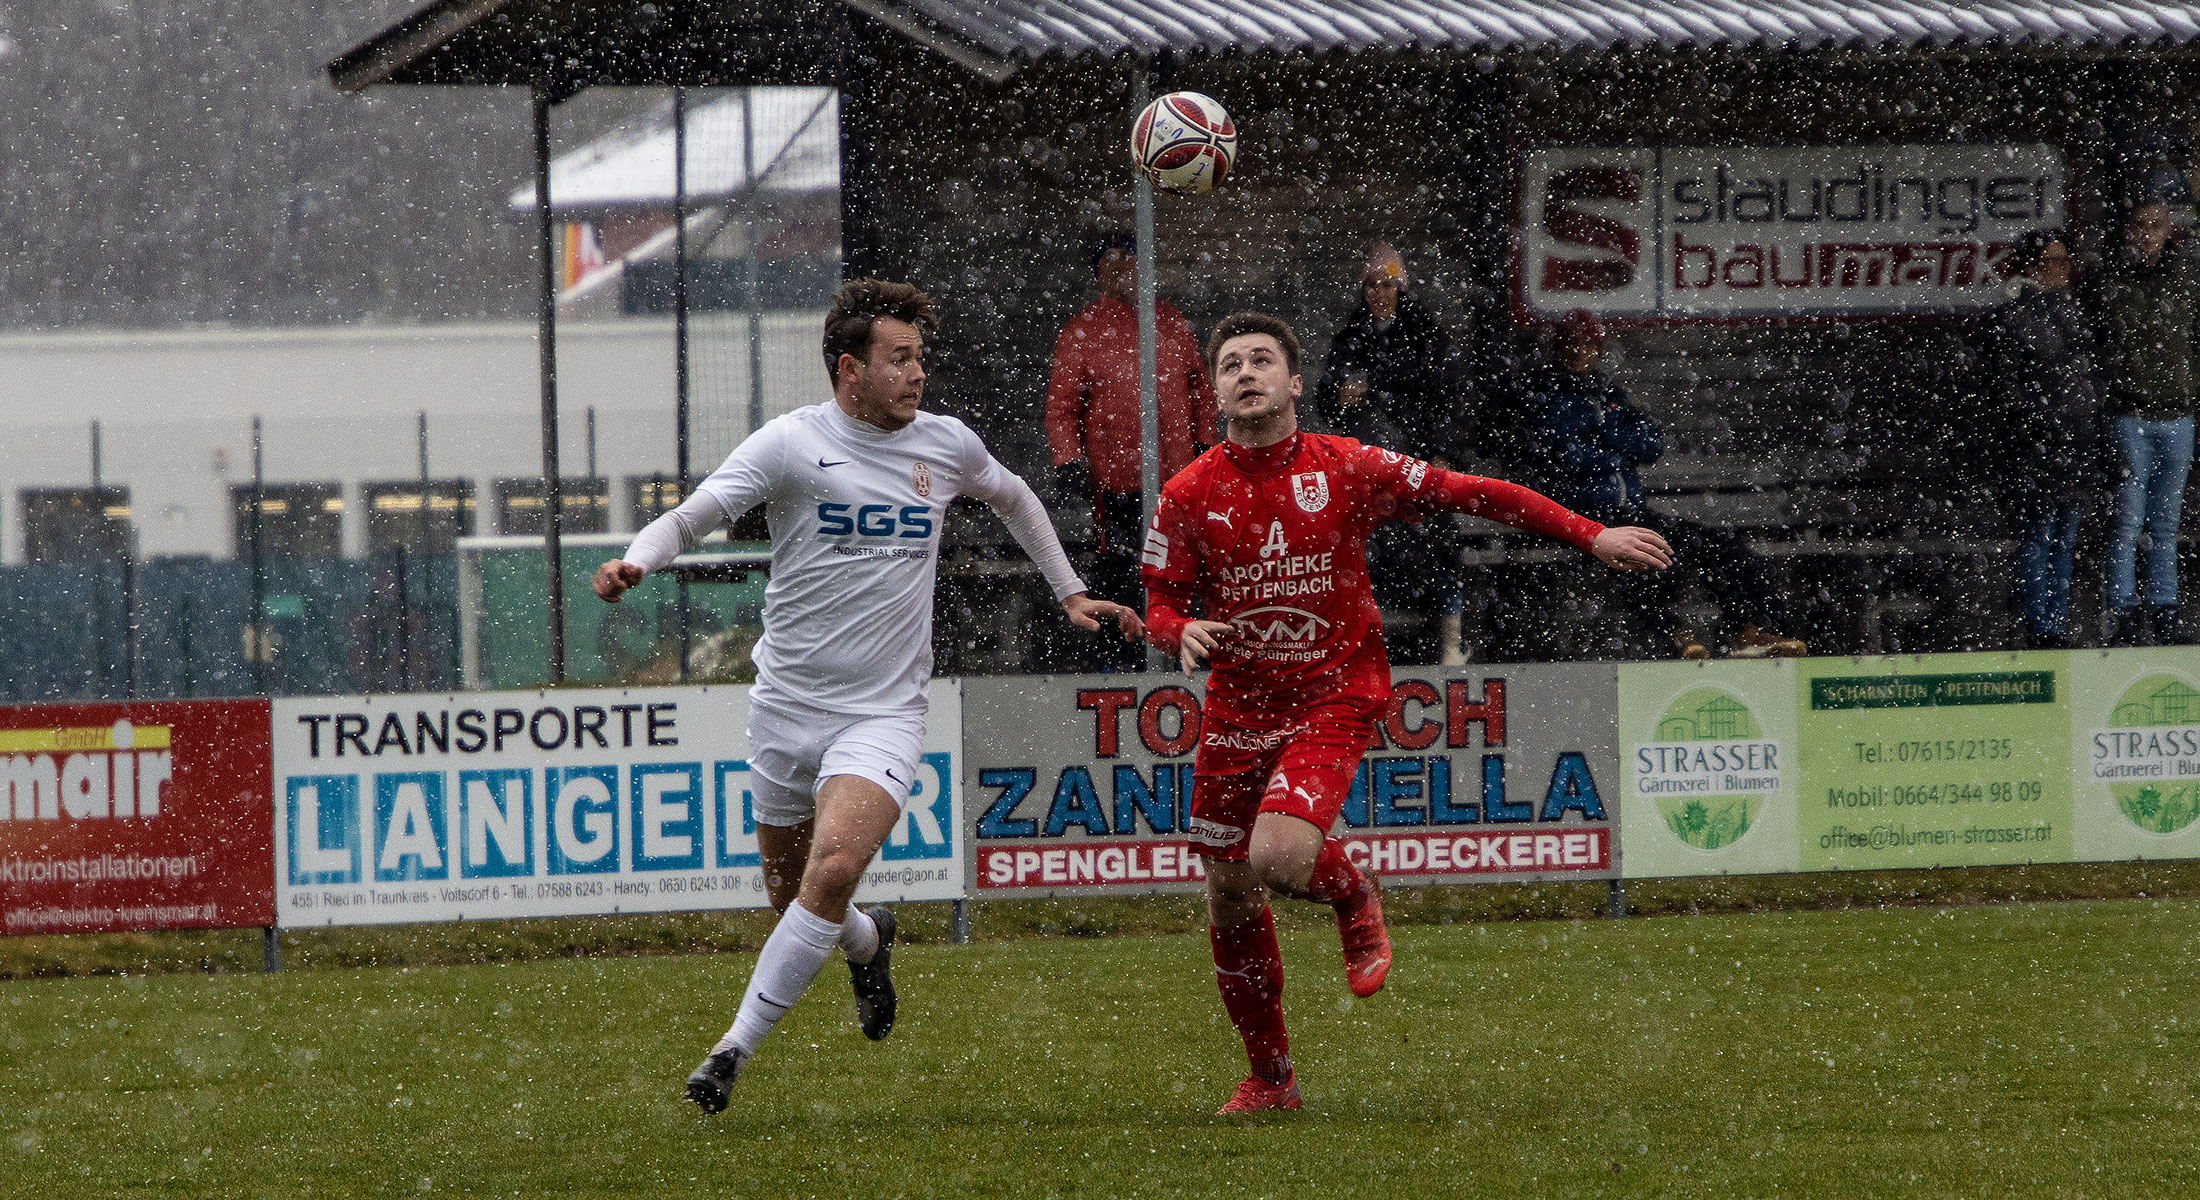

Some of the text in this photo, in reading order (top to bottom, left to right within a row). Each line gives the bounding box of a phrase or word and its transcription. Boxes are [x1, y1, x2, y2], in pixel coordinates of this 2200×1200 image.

[1673, 164, 2053, 234] staudinger
[1673, 232, 2025, 289] baumark
[817, 502, 932, 539] SGS
[833, 546, 930, 559] INDUSTRIAL SERVICES
[1221, 552, 1333, 584] APOTHEKE
[1221, 575, 1333, 601] PETTENBACH
[1946, 681, 2042, 698] PETTENBACH
[55, 727, 107, 748] GmbH
[298, 703, 679, 758] TRANSPORTE
[1637, 743, 1779, 774] STRASSER
[1854, 738, 2012, 763] Tel.: 07615/2135
[1638, 775, 1710, 794] Gärtnerei
[1725, 774, 1779, 791] Blumen
[1828, 780, 2042, 808] Mobil: 0664/344 98 09
[298, 759, 946, 873] LANGEDR
[1819, 822, 2053, 851] office@blumen-strasser.at
[323, 891, 350, 907] Ried
[353, 892, 366, 906] im
[371, 889, 430, 905] Traunkreis
[440, 885, 490, 901] Voitsdorf
[492, 886, 500, 900] 6
[511, 884, 534, 900] Tel.:
[537, 882, 572, 898] 07588
[575, 881, 603, 897] 6243
[659, 878, 687, 894] 0650
[690, 876, 718, 892] 6243
[721, 875, 742, 891] 308
[4, 902, 218, 927] office@elektro-kremsmair.at
